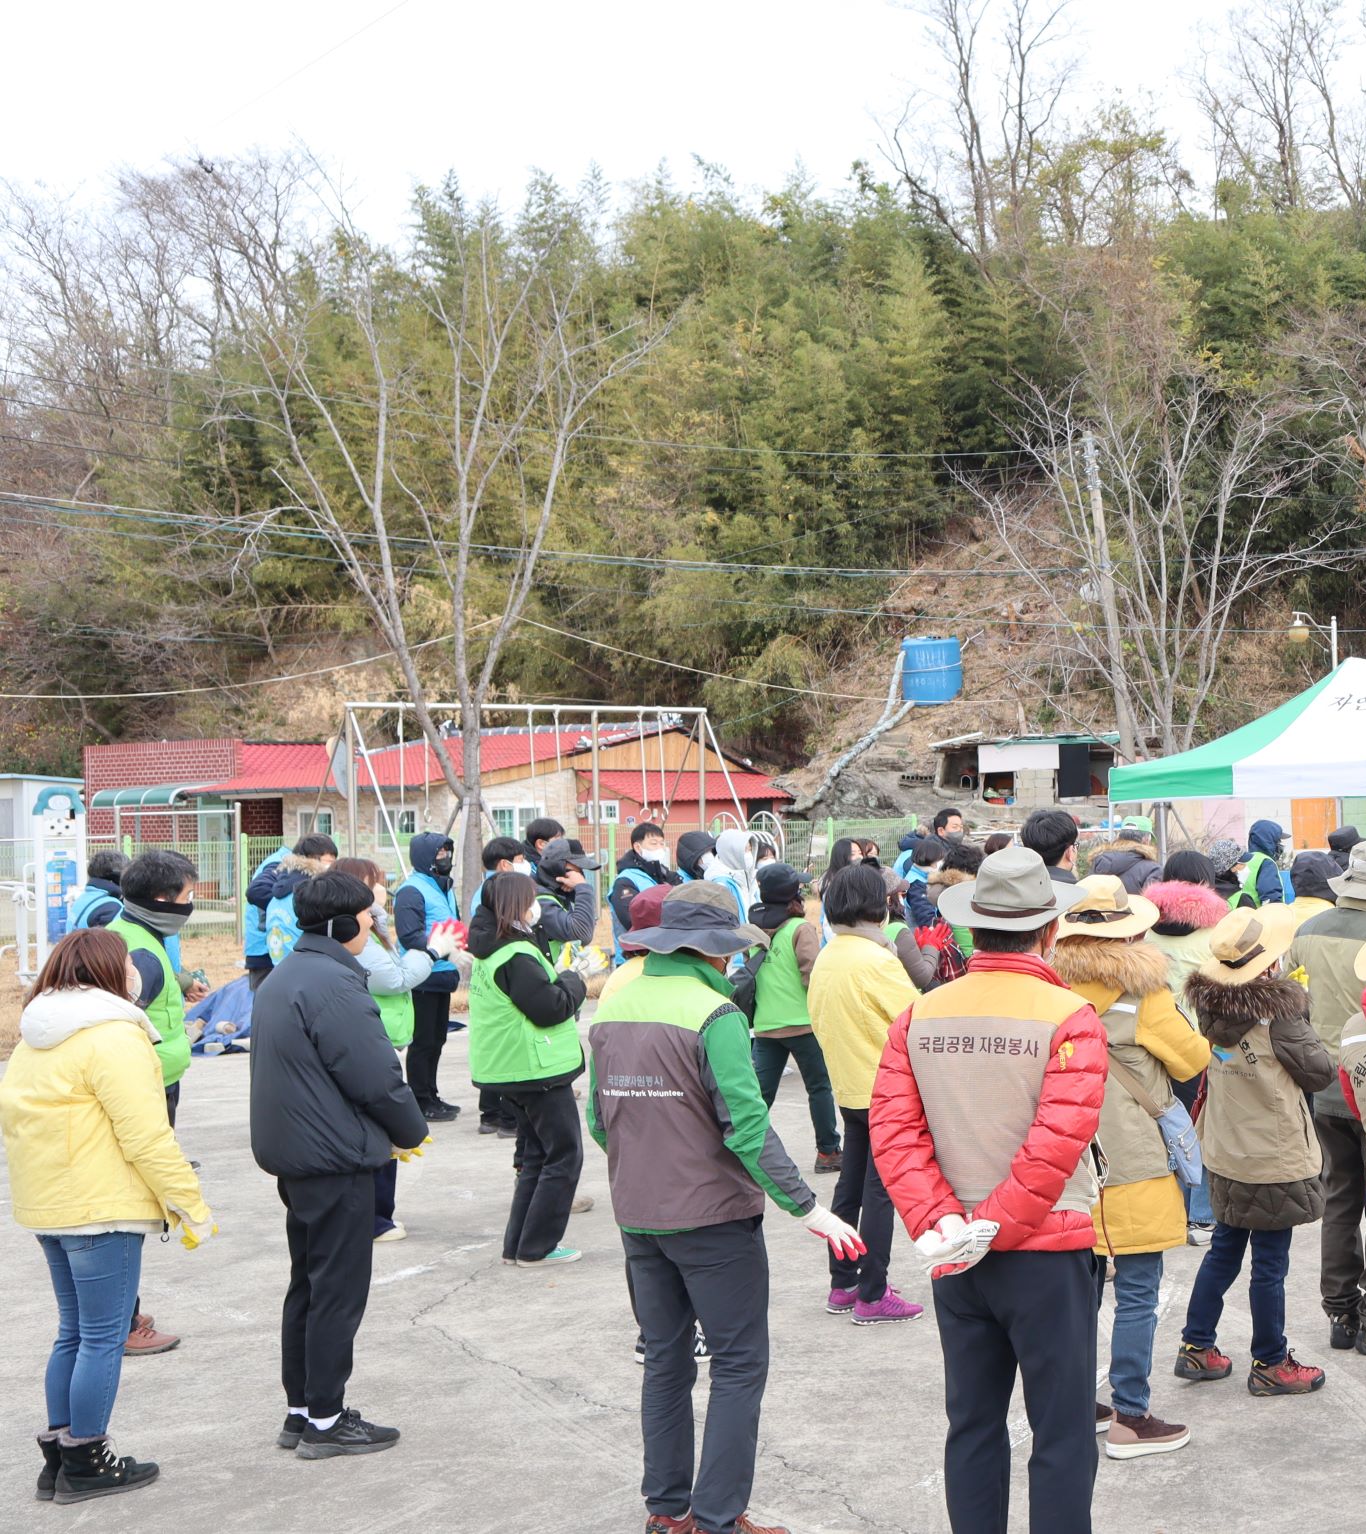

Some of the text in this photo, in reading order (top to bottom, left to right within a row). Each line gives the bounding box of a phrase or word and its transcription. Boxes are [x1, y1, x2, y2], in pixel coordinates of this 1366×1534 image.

[919, 1036, 1040, 1058] 국립공원 자원봉사
[631, 1089, 646, 1097] Park
[647, 1089, 684, 1097] Volunteer
